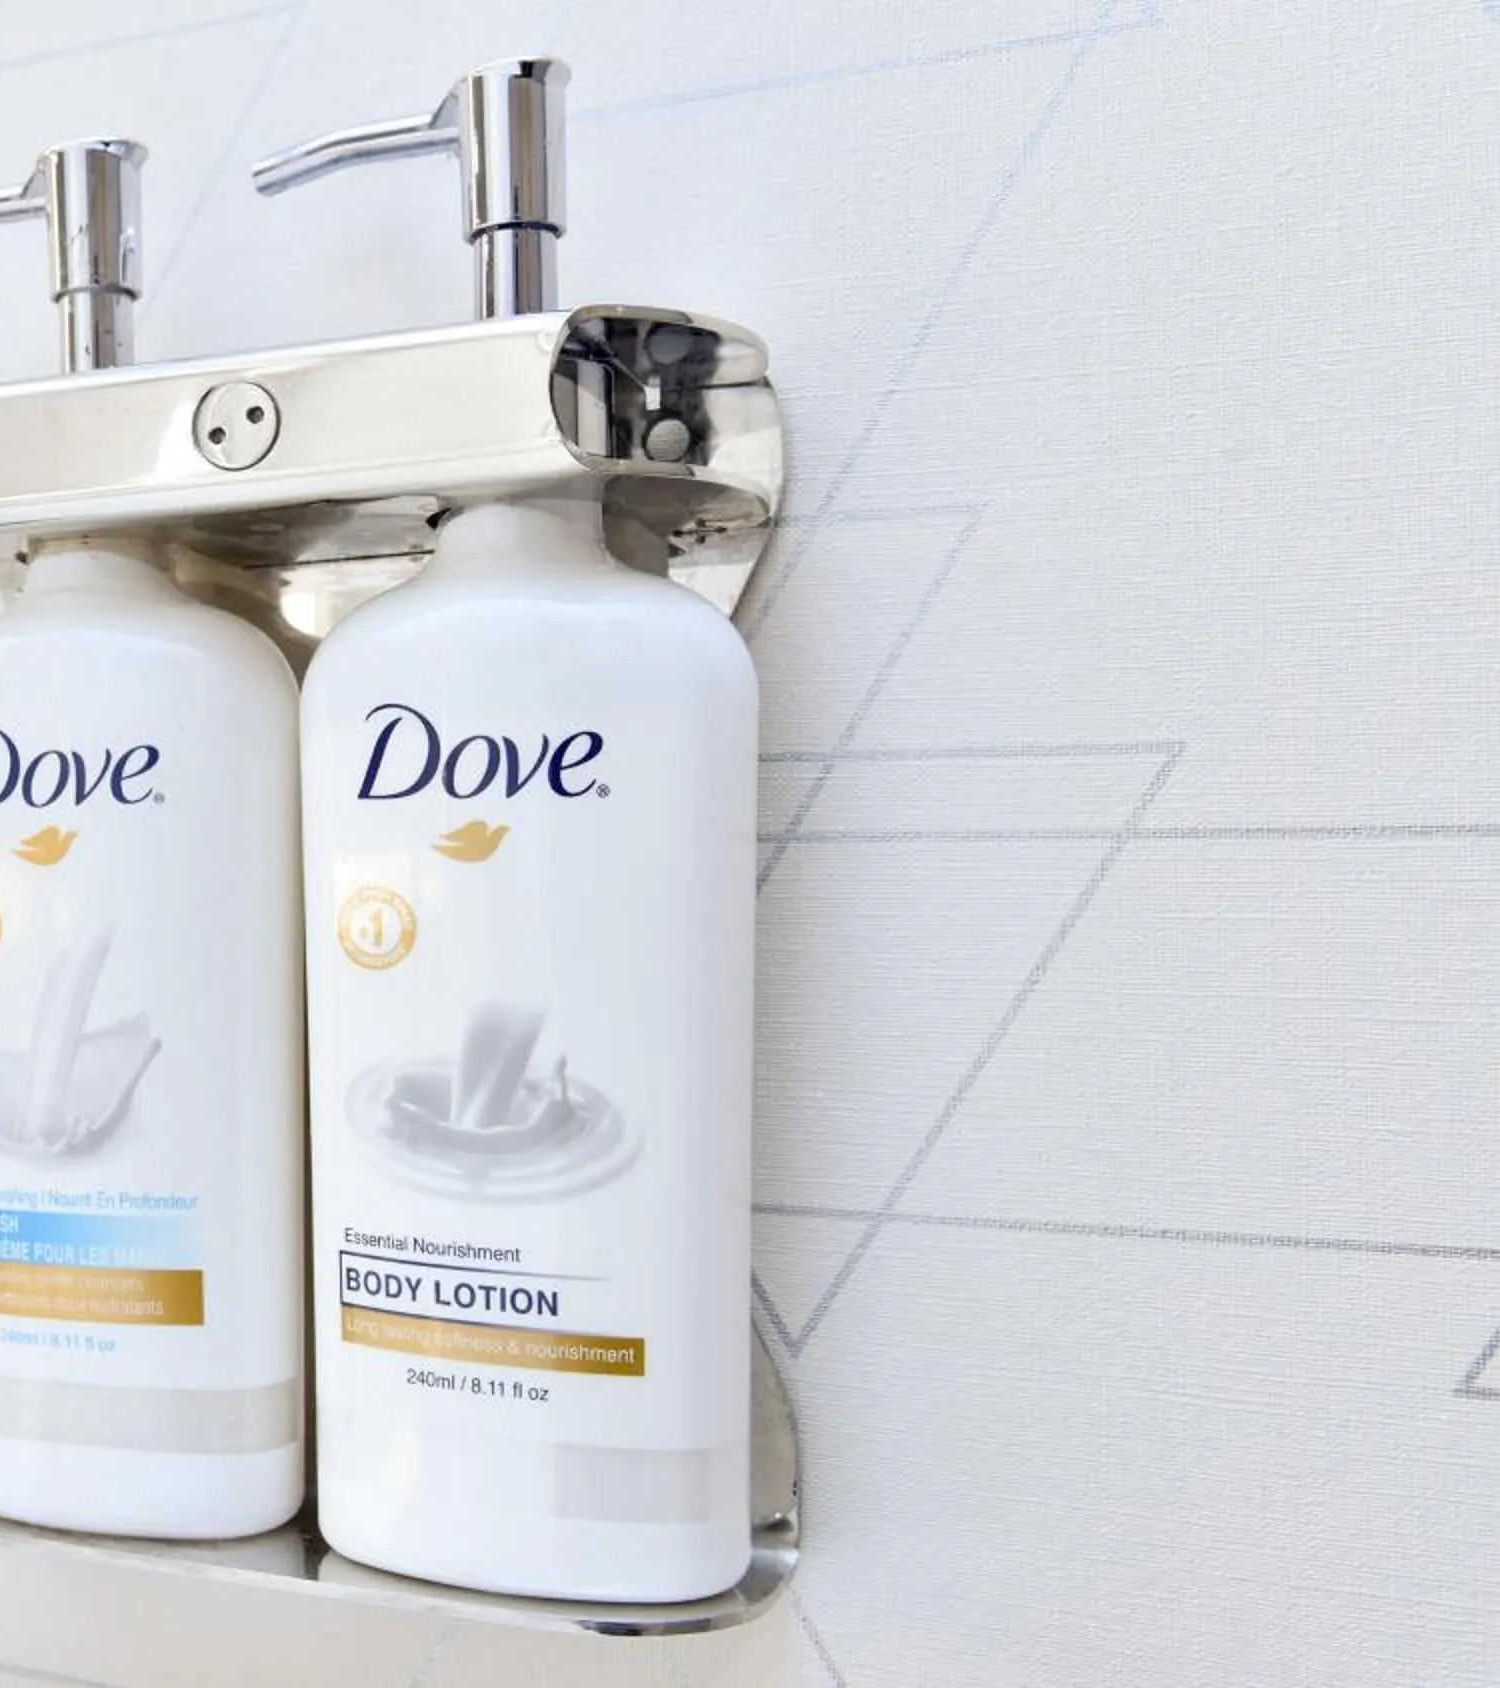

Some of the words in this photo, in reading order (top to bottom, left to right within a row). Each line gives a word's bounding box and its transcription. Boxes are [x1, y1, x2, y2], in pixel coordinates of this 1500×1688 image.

[357, 703, 603, 800] Dove
[97, 1190, 115, 1208] En
[119, 1191, 198, 1211] Profondeur
[33, 1241, 75, 1265] POUR
[344, 1227, 409, 1251] Essential
[413, 1237, 521, 1264] Nourishment
[346, 1266, 422, 1302] BODY
[435, 1279, 559, 1317] LOTION
[526, 1339, 635, 1364] nourishment
[406, 1367, 456, 1390] 240ml
[471, 1378, 505, 1398] 8.11
[512, 1381, 523, 1399] fl
[528, 1385, 549, 1402] oz
